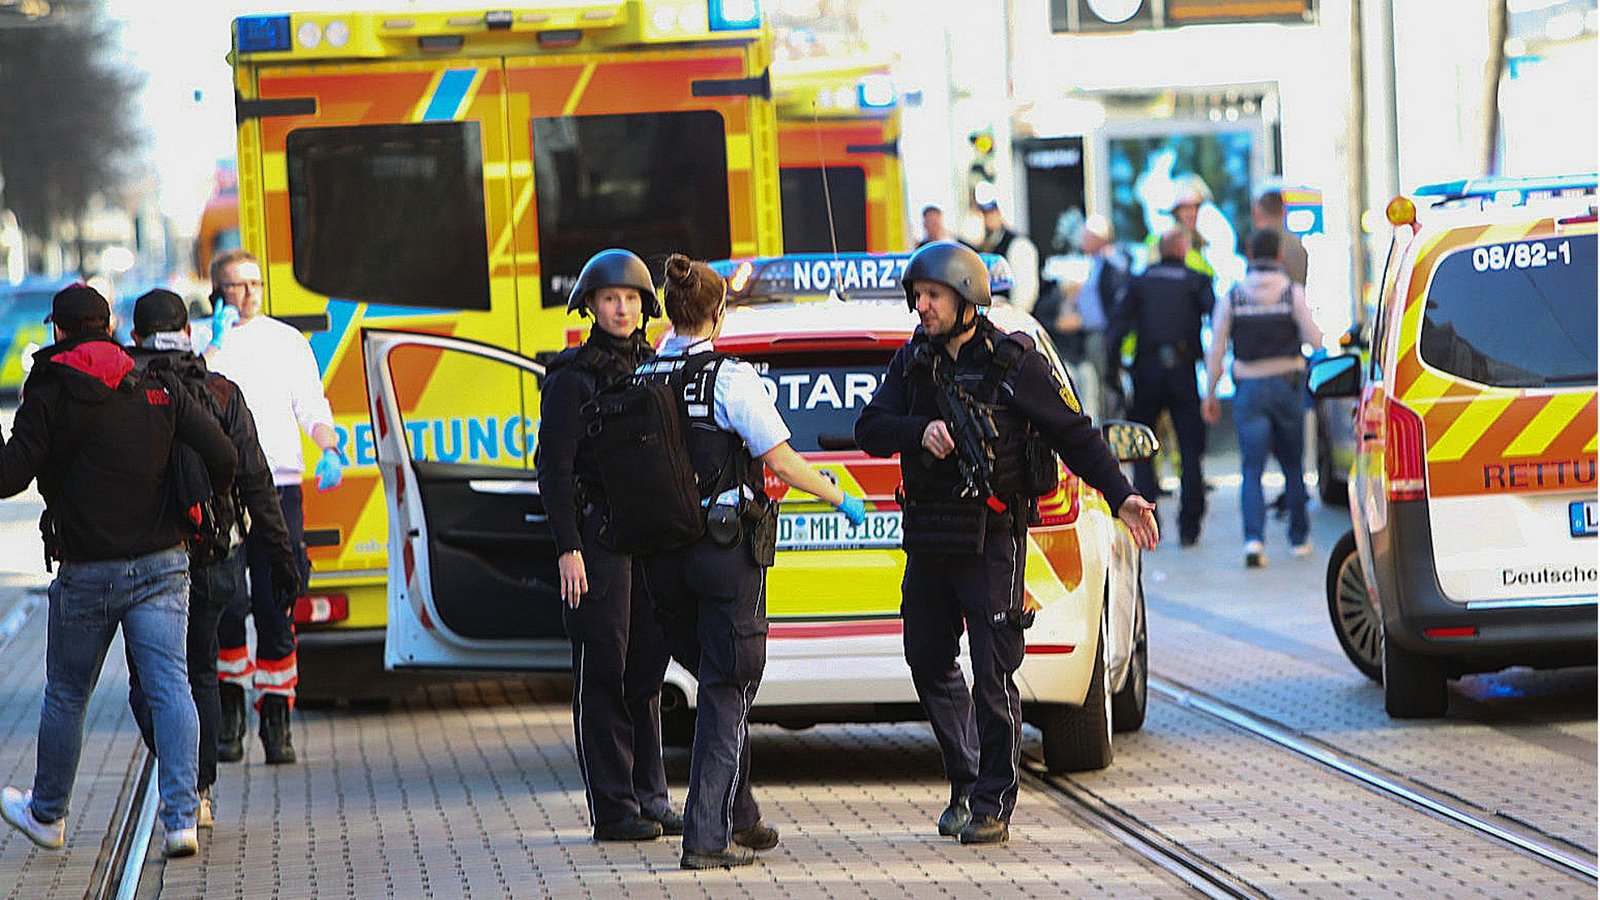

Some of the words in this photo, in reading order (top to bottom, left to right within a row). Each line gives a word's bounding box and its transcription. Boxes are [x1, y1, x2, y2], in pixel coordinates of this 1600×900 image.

[1473, 240, 1571, 272] 08/82-1
[759, 373, 886, 410] TAR
[1484, 461, 1596, 488] RETTU
[810, 518, 838, 541] MH
[1503, 566, 1598, 586] Deutsche
